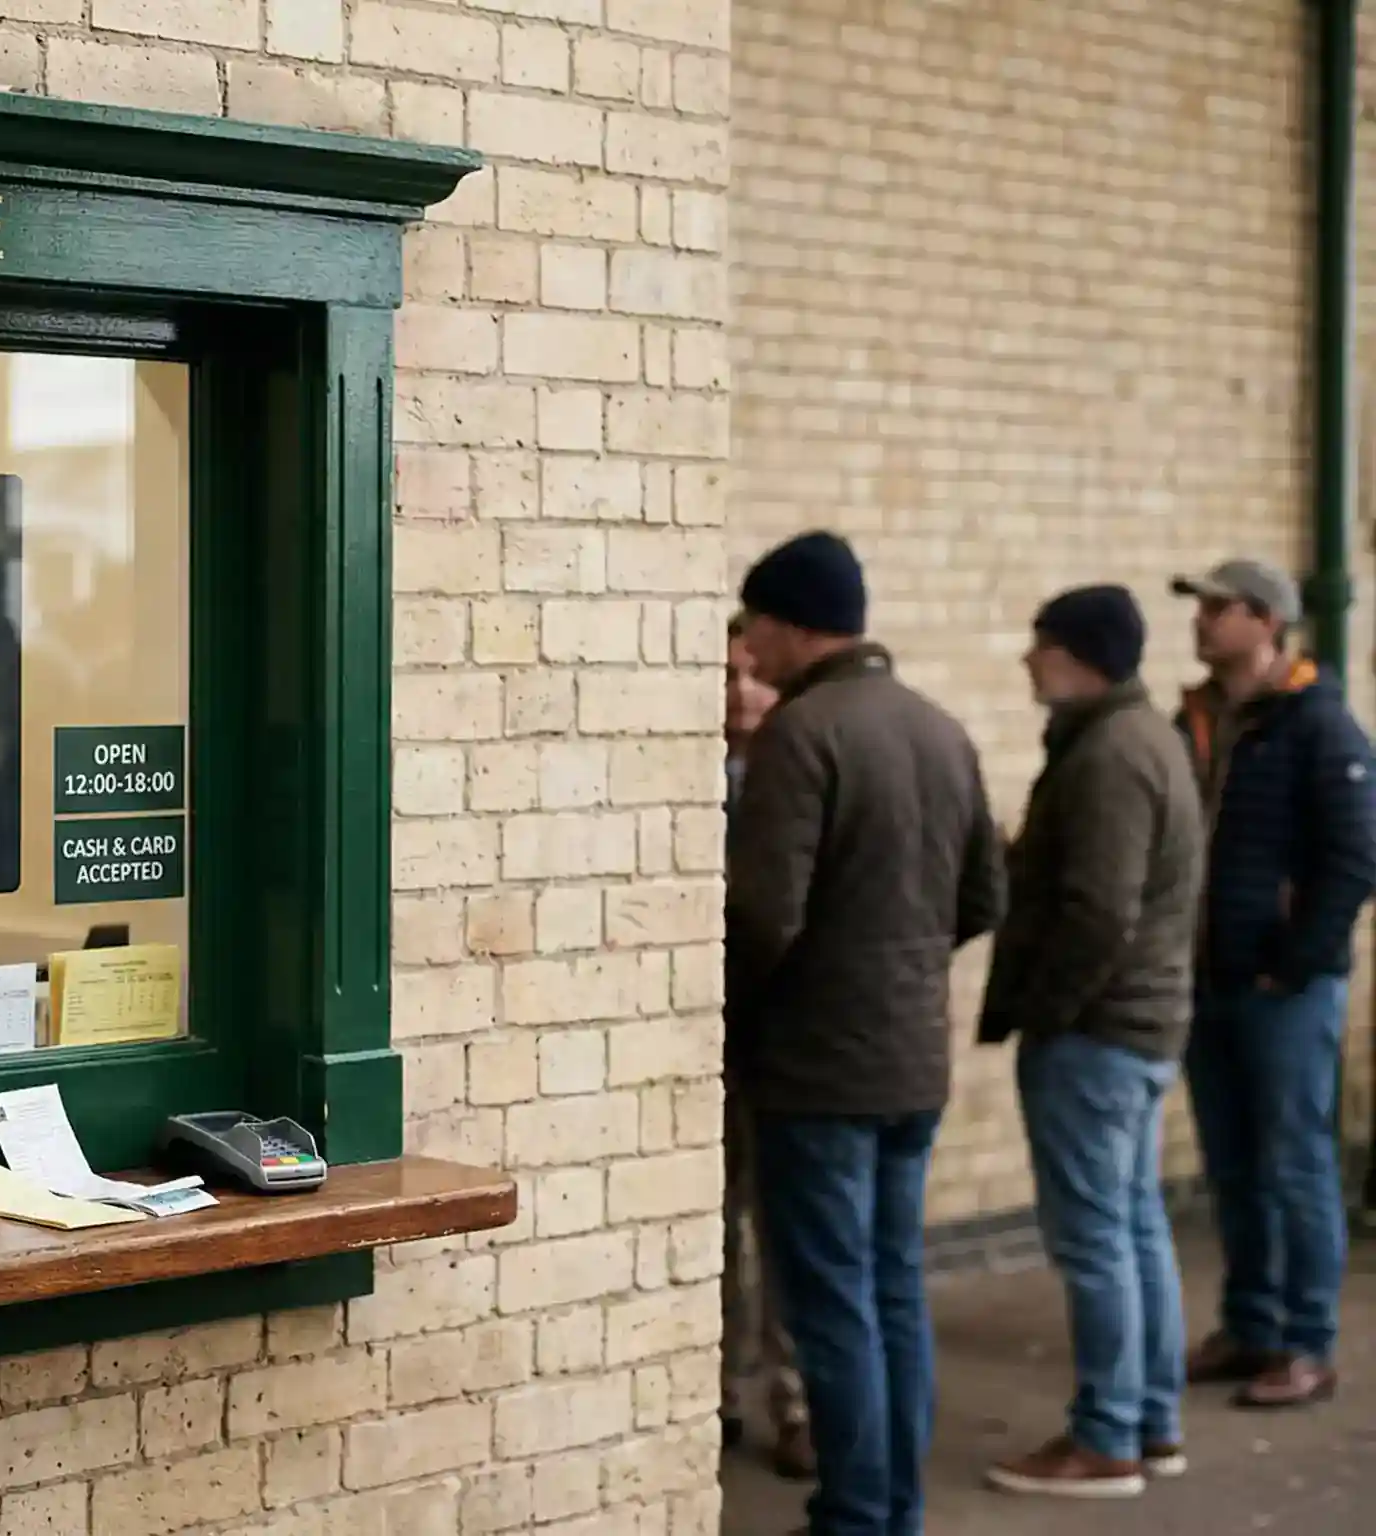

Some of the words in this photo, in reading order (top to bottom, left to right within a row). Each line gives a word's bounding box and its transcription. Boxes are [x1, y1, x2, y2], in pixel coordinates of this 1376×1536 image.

[94, 743, 146, 765] OPEN
[64, 771, 175, 795] 12:00-18:00
[62, 838, 108, 859] CASH
[112, 836, 127, 857] &
[130, 835, 176, 856] CARD
[76, 861, 163, 885] ACCEPTED
